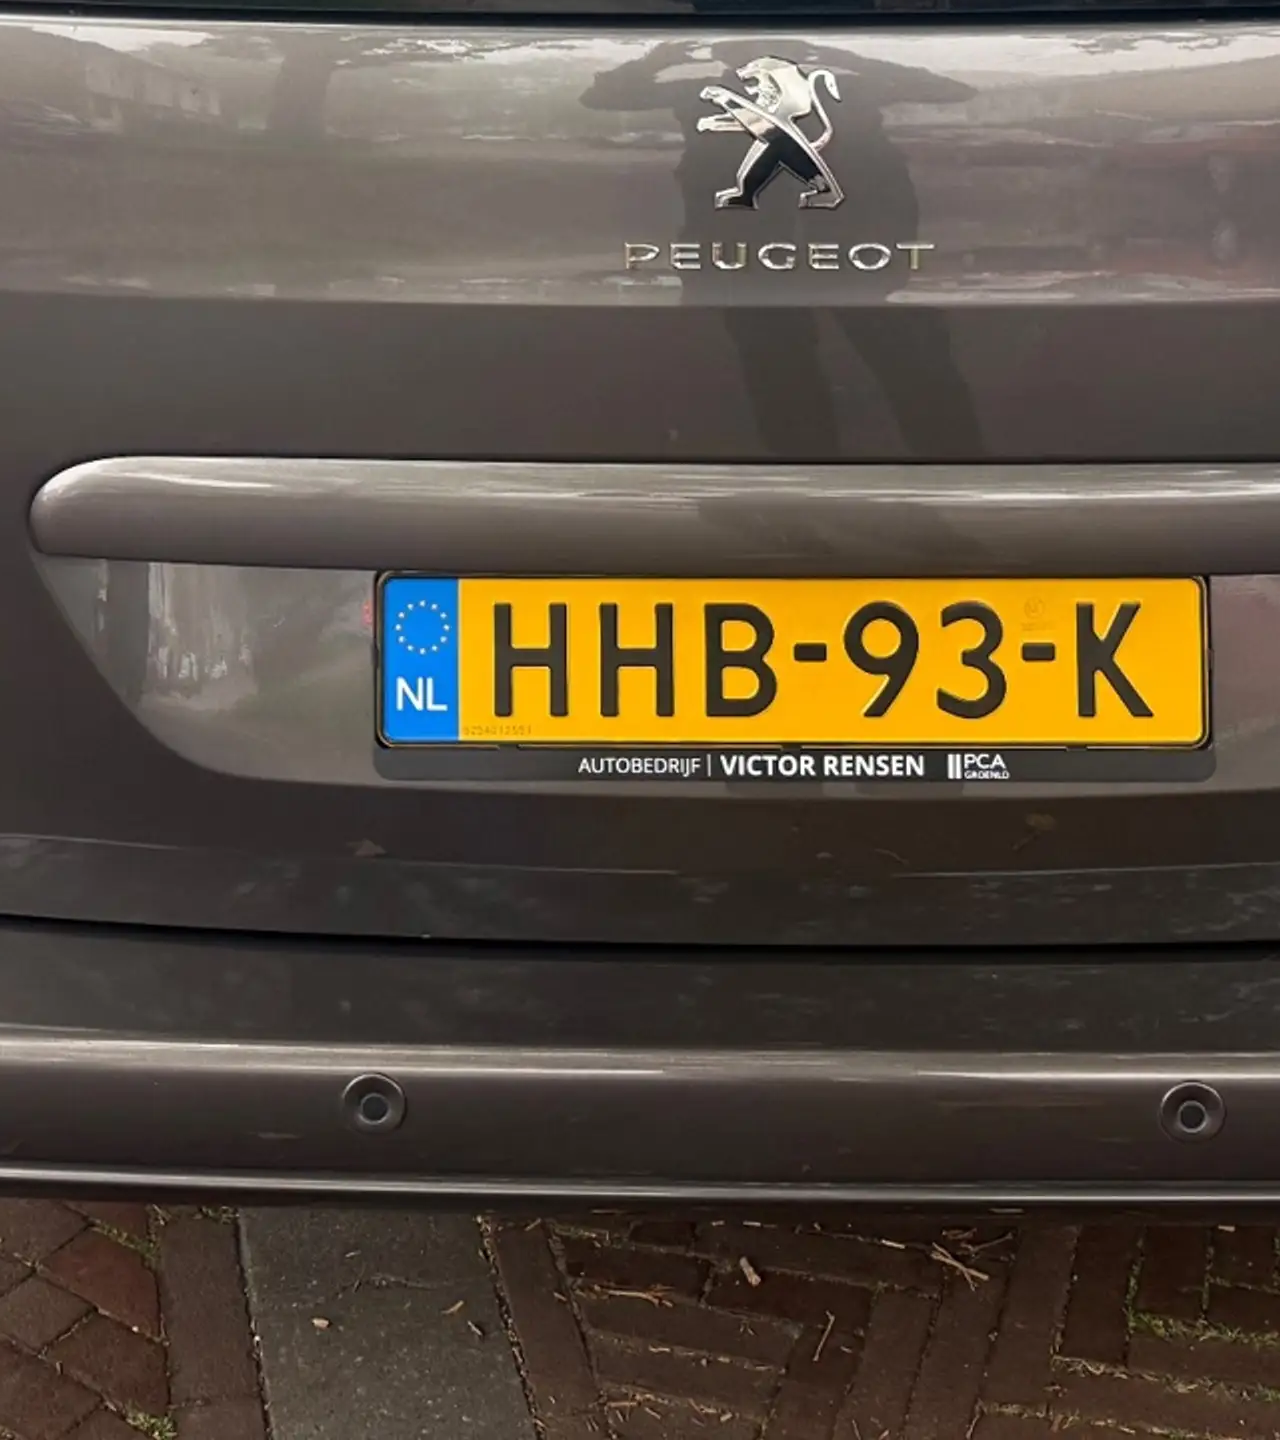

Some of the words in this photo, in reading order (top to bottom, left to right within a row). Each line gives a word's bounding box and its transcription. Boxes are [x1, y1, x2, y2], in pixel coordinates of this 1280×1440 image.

[624, 241, 935, 271] PEUGEOT
[493, 600, 1154, 719] HHB-93-K
[395, 676, 448, 711] NL
[578, 757, 701, 777] AUTOBEDRIJF
[720, 754, 816, 776] VICTOR
[823, 754, 925, 776] RENSEN
[963, 753, 1007, 769] PCA
